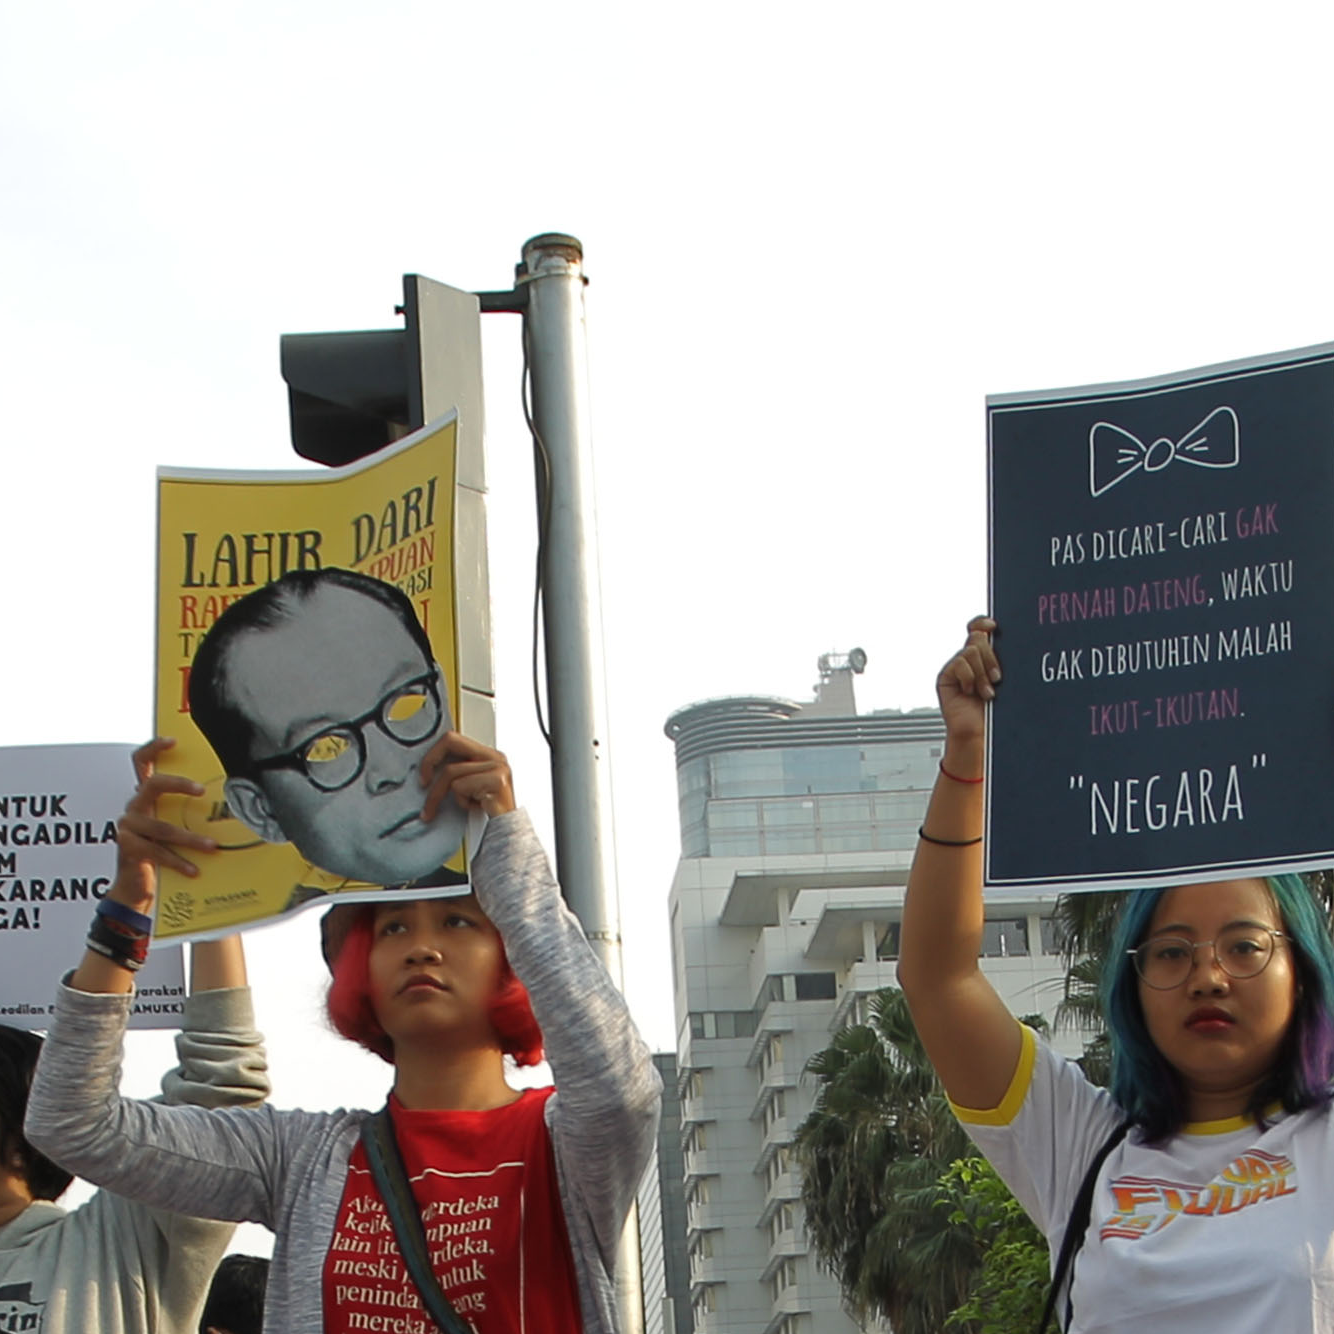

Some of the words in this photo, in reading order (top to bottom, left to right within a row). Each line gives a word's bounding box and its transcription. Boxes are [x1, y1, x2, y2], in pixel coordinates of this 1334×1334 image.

[181, 529, 323, 588] LAHIR
[349, 475, 438, 567] DARI
[1051, 533, 1085, 567] PAS
[1092, 511, 1229, 562] DICARI-CARI
[1235, 503, 1280, 539] GAK
[1038, 586, 1116, 625] PERNAH
[1123, 574, 1214, 616] DATENG,
[1221, 559, 1294, 601] WAKTU
[1041, 649, 1084, 683] GAK
[1091, 633, 1210, 678] DIBUTUHIN
[1217, 620, 1292, 662] MALAH
[1089, 687, 1246, 736] IKUT-IKUTAN.
[1069, 752, 1267, 836] "NEGARA"
[135, 985, 184, 999] yarakat
[348, 1195, 384, 1214] Aku
[345, 1212, 393, 1235] ketik
[332, 1232, 371, 1254] lain
[333, 1258, 398, 1280] meski
[336, 1284, 424, 1310] peninda
